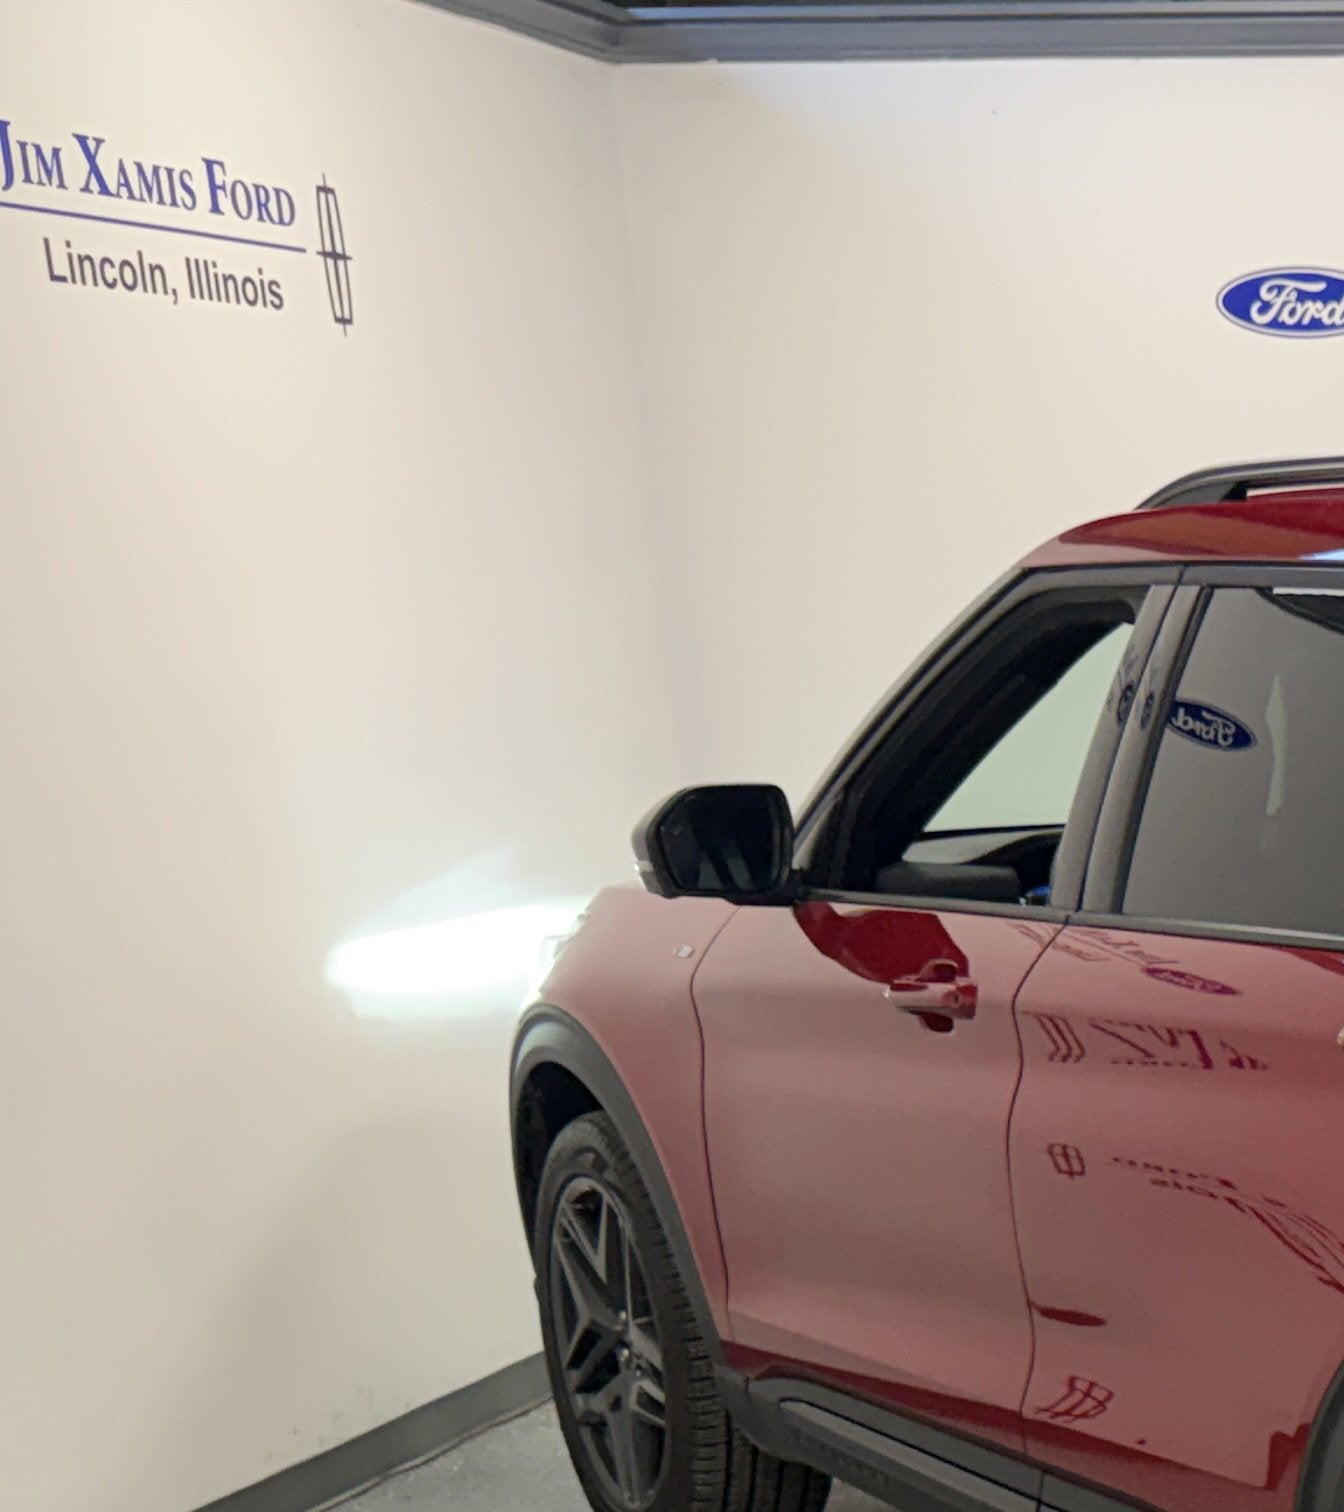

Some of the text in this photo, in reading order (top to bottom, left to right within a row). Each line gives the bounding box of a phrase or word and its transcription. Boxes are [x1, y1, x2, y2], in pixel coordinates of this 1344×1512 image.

[72, 133, 197, 211] XAMIS
[201, 157, 296, 227] FORD
[43, 237, 285, 311] Lincoln, Illinois
